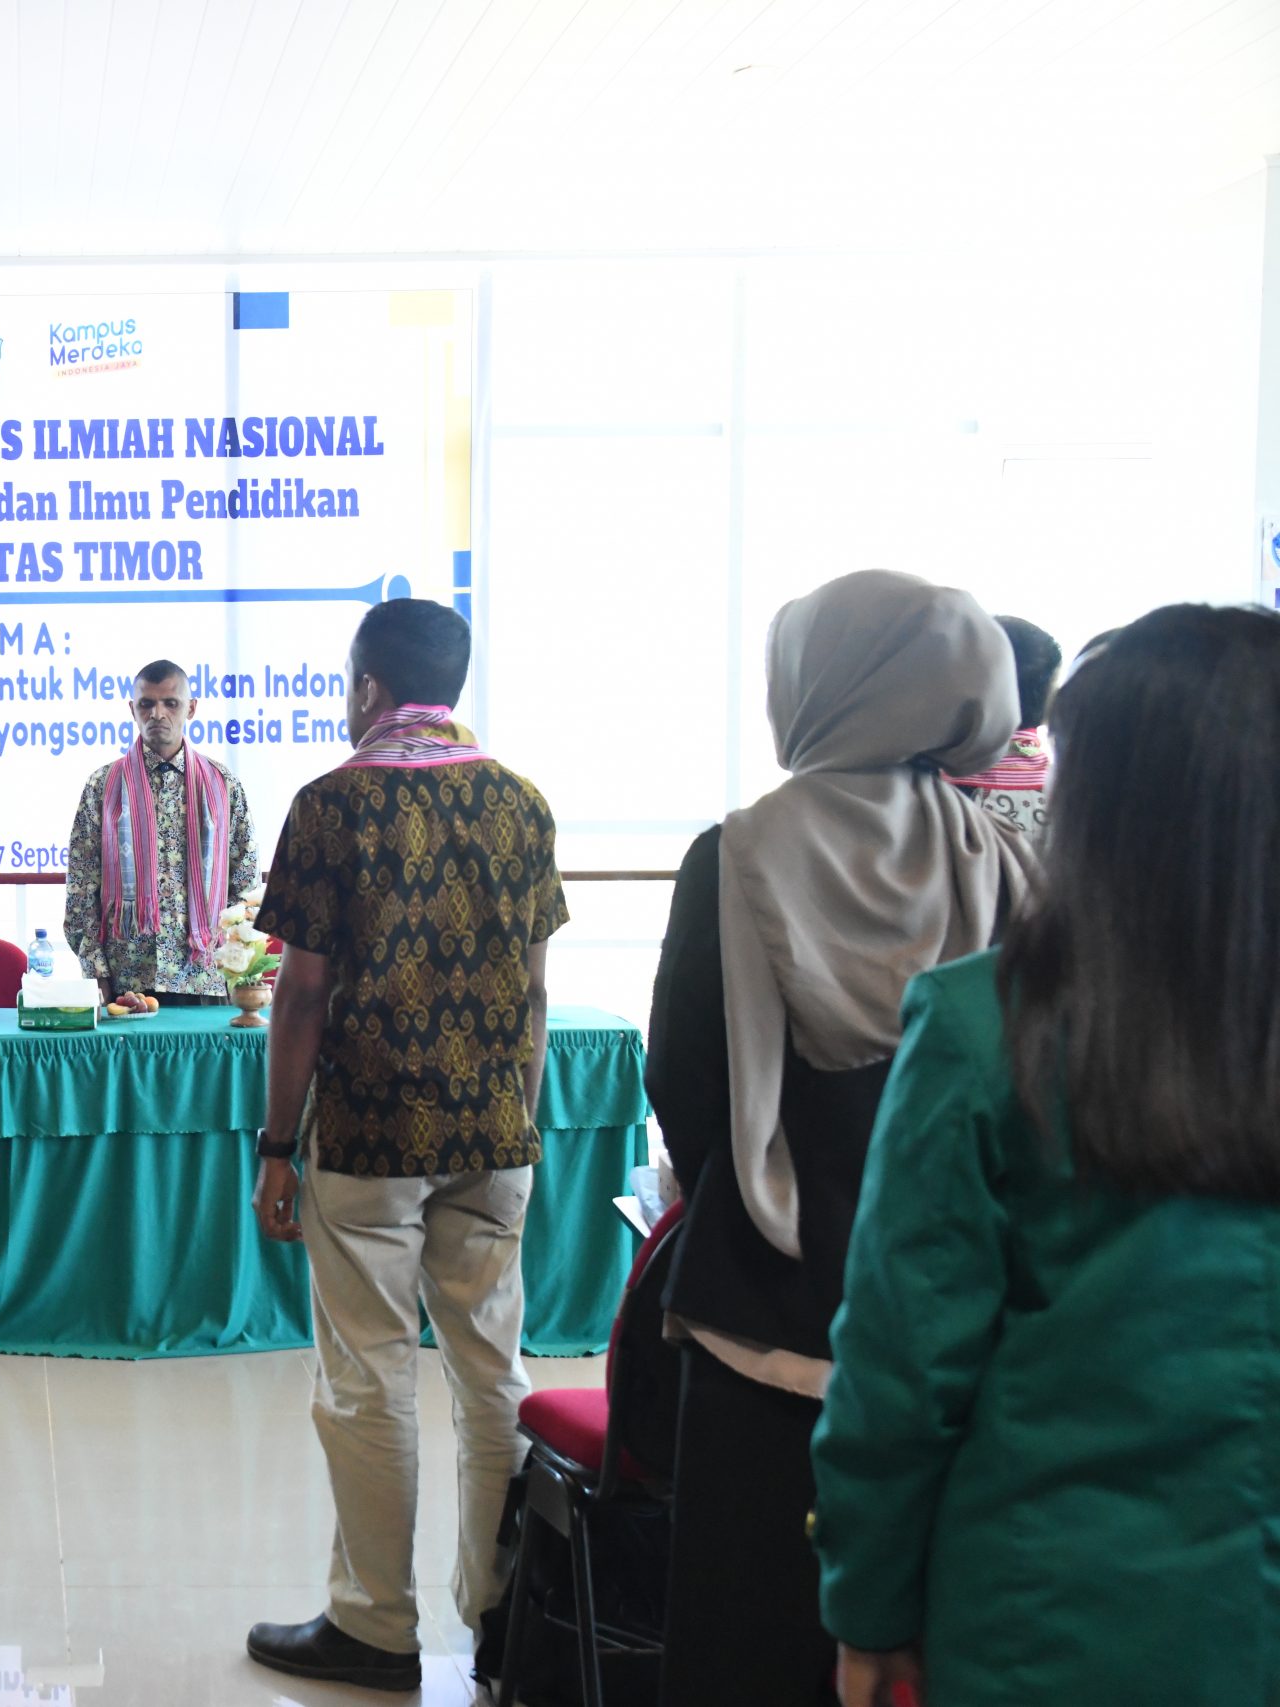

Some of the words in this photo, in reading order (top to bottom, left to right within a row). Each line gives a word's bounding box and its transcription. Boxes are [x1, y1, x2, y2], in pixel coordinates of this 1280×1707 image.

[49, 318, 137, 345] Kampus
[50, 337, 143, 367] Merdeka
[57, 364, 110, 377] INDONESIA
[115, 360, 138, 370] JAYA
[33, 418, 175, 460] ILMIAH
[184, 415, 385, 458] NASIONAL
[68, 480, 151, 521] Ilmu
[161, 477, 360, 520] Pendidikan
[73, 540, 203, 582] TIMOR
[73, 663, 255, 701] Mewdkan
[265, 662, 345, 698] Indon
[183, 708, 282, 745] onesia
[292, 709, 351, 744] Ema
[10, 840, 69, 874] Septe
